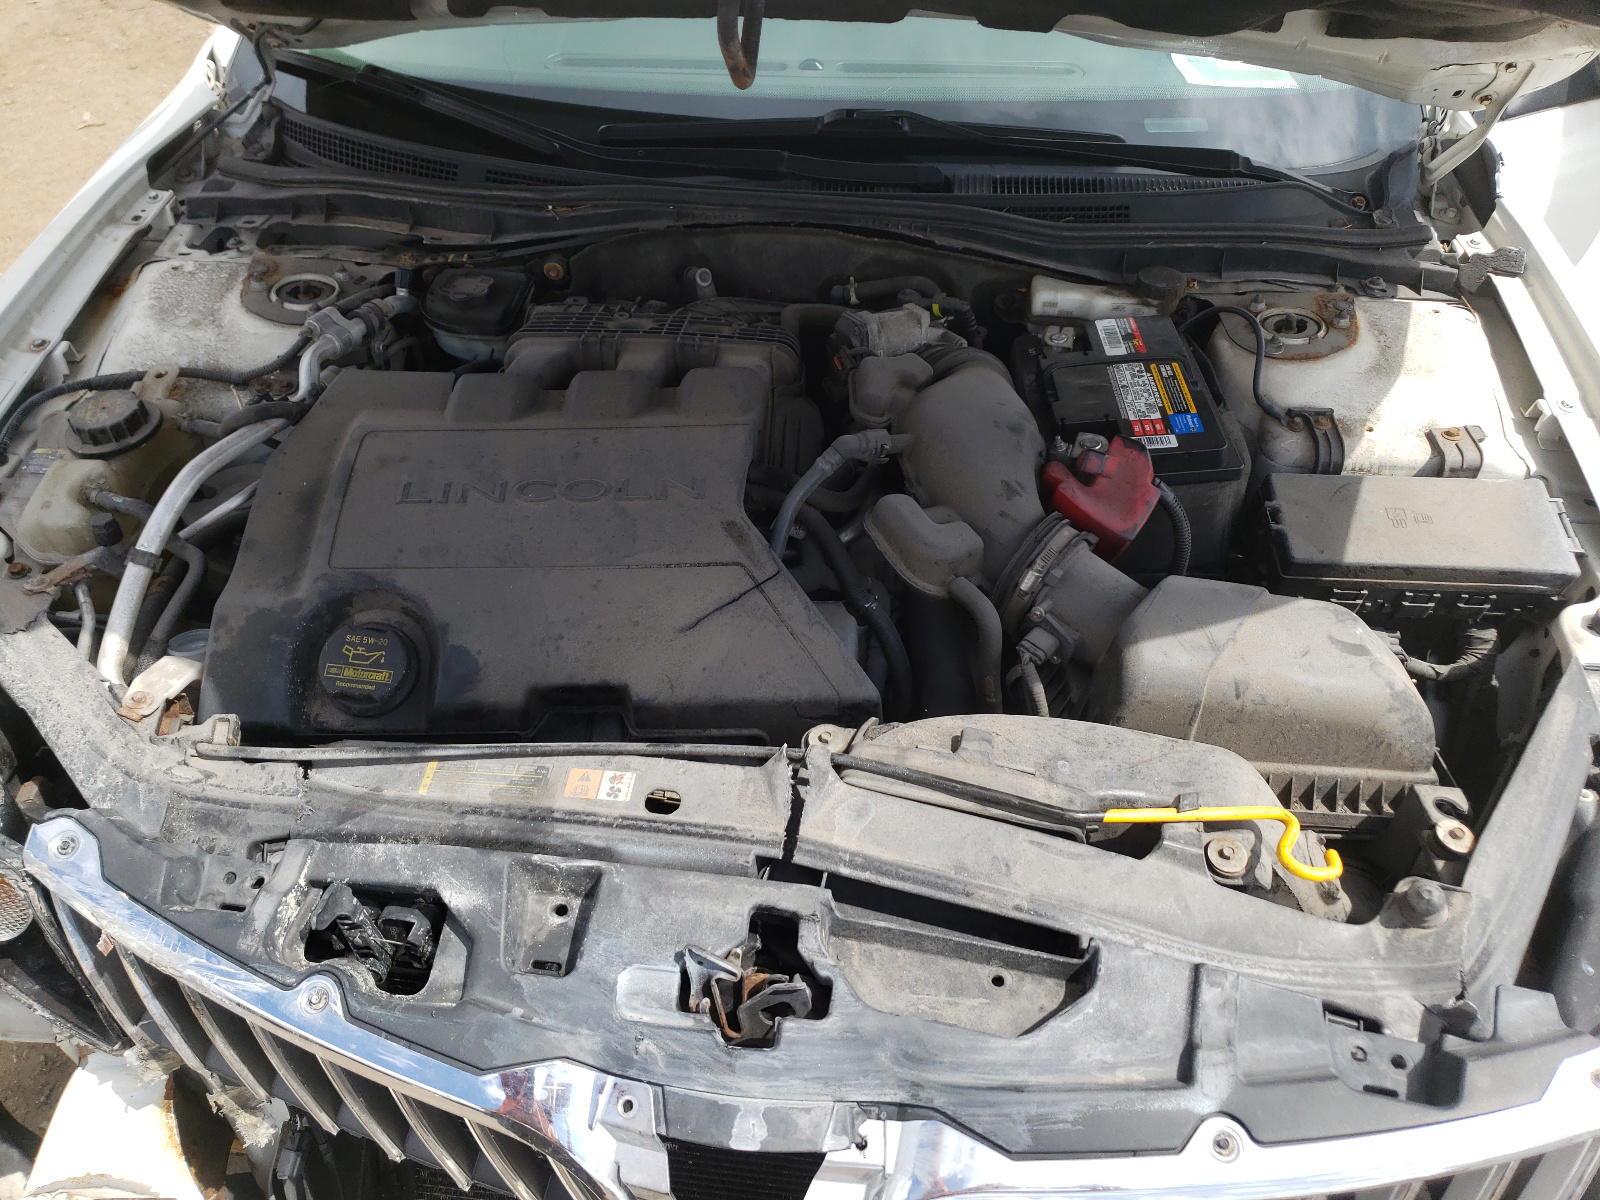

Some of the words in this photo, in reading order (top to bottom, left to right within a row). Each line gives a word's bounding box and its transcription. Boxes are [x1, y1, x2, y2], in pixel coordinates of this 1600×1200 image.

[395, 478, 706, 505] LINCOLN
[346, 635, 361, 643] SAE
[362, 635, 388, 646] 5W-20
[343, 667, 390, 681] Motorcraft
[336, 681, 375, 690] Recommended
